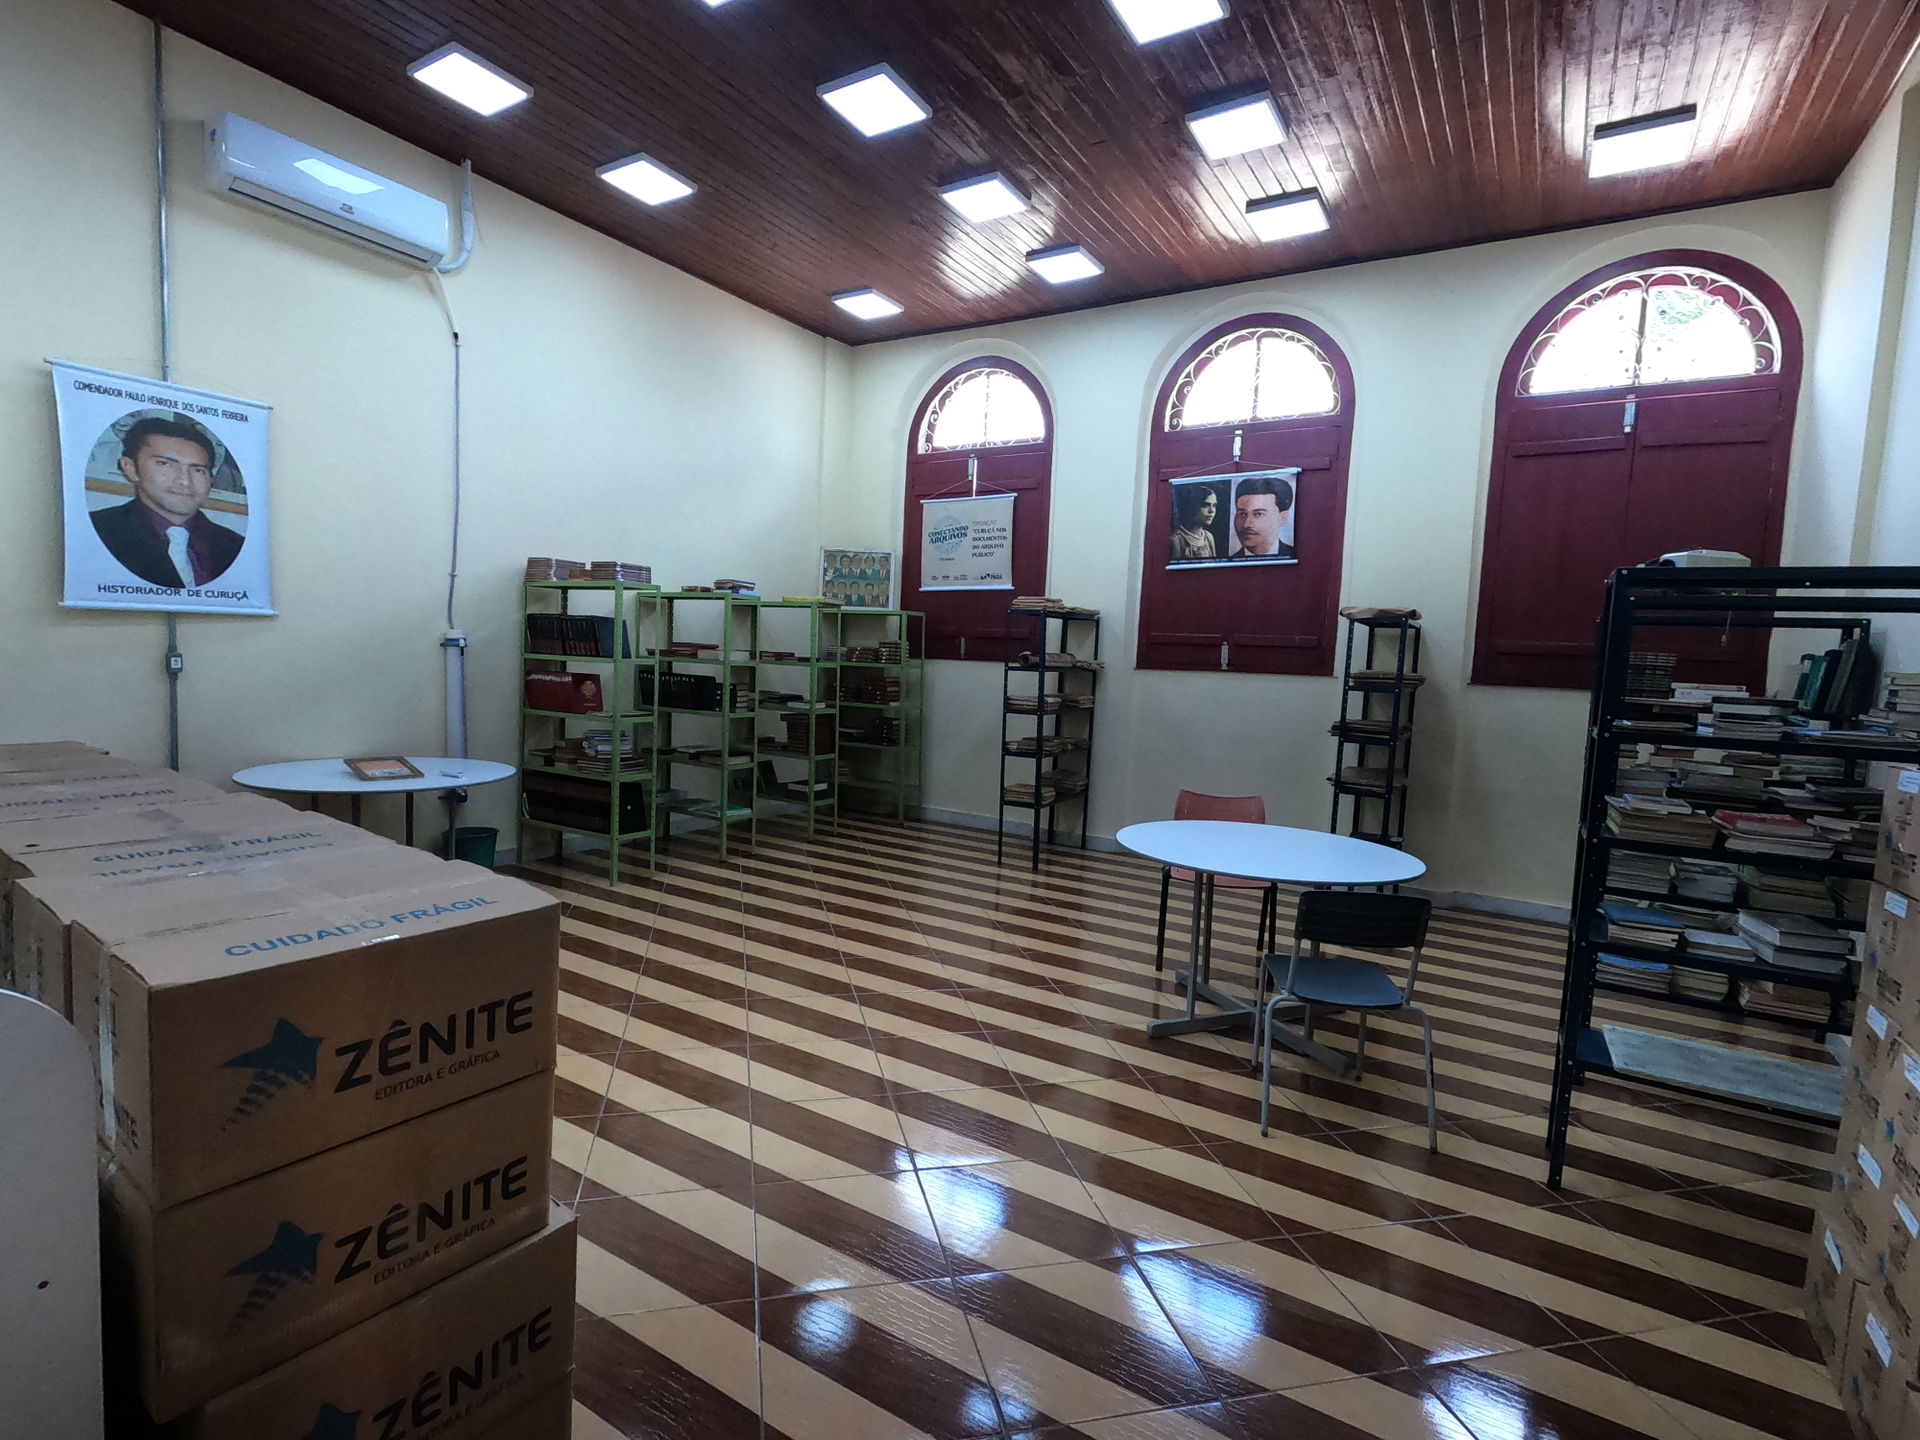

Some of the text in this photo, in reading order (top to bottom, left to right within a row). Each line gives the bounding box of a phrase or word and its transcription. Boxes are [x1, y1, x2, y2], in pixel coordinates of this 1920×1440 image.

[73, 380, 249, 422] COMENDADOR PAULO HENRIQUE DOS SANTOS FERREIRA
[928, 525, 969, 538] CONECTANDO
[929, 531, 968, 545] ARQUIVOS
[97, 584, 249, 601] HISTORIADOR DE CURUÇÁ
[92, 830, 323, 863] CUIDADO FRÁGIL
[224, 895, 499, 957] CUIDADO FRÁGIL
[333, 989, 534, 1094] ZÊNITE
[375, 1048, 500, 1101] EDITORA E GRÁFICA
[332, 1154, 528, 1286] ZÊNITE
[374, 1216, 496, 1285] EDITORA E GRÁFICA
[372, 1305, 553, 1440] ZÊNITE
